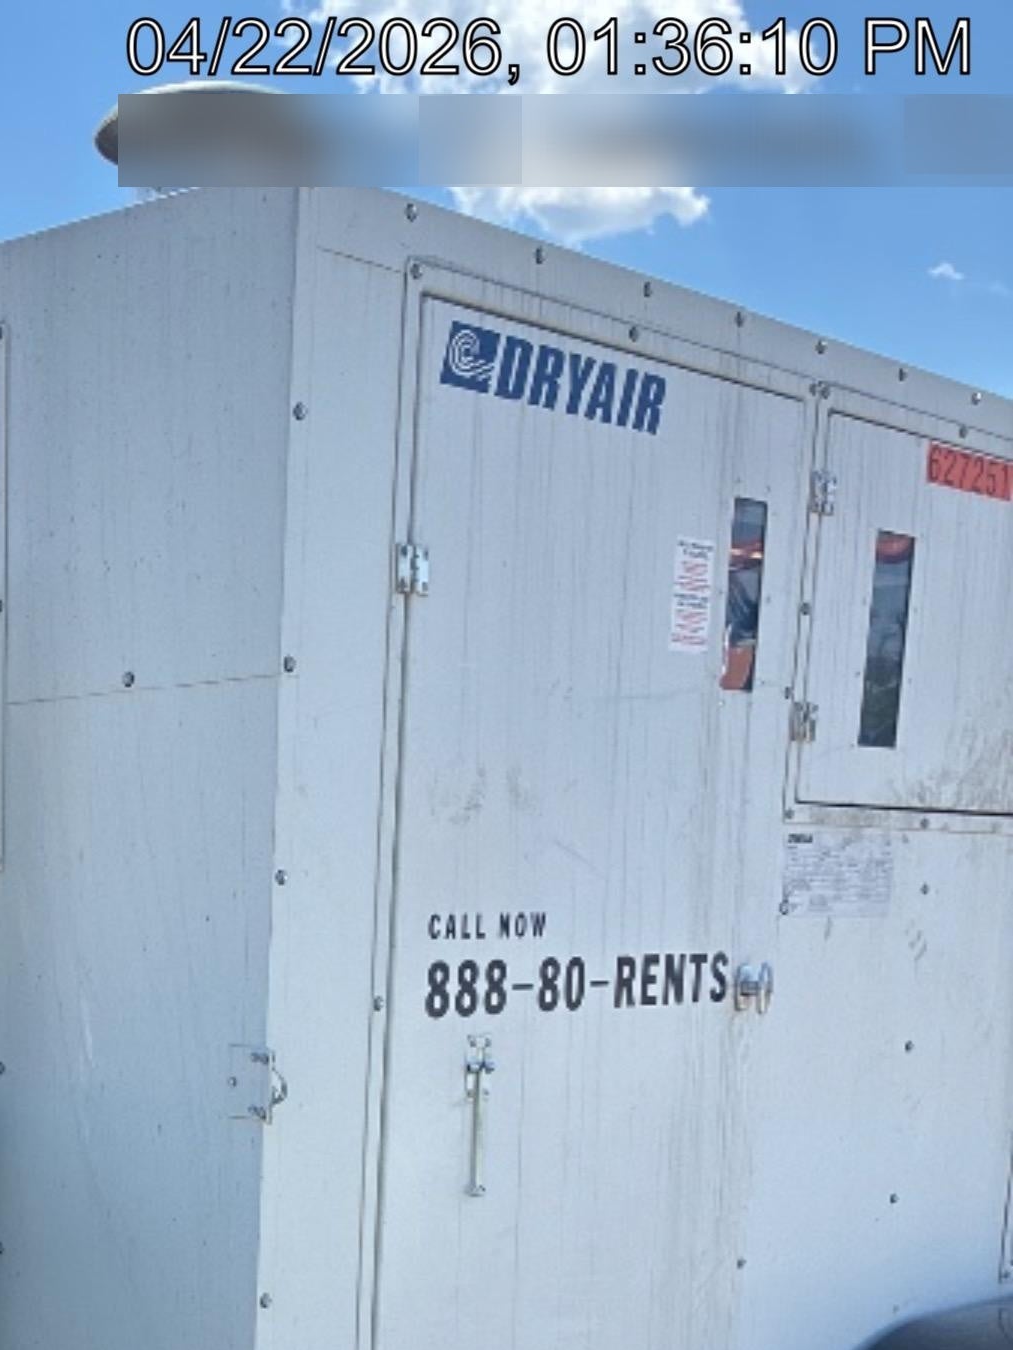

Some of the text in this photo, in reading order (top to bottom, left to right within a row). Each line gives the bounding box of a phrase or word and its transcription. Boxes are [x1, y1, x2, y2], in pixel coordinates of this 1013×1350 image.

[493, 335, 666, 435] DRYAIR
[928, 444, 1011, 501] 627251
[427, 911, 547, 940] CALL NOW
[424, 951, 729, 1019] 888-80-RENTS
